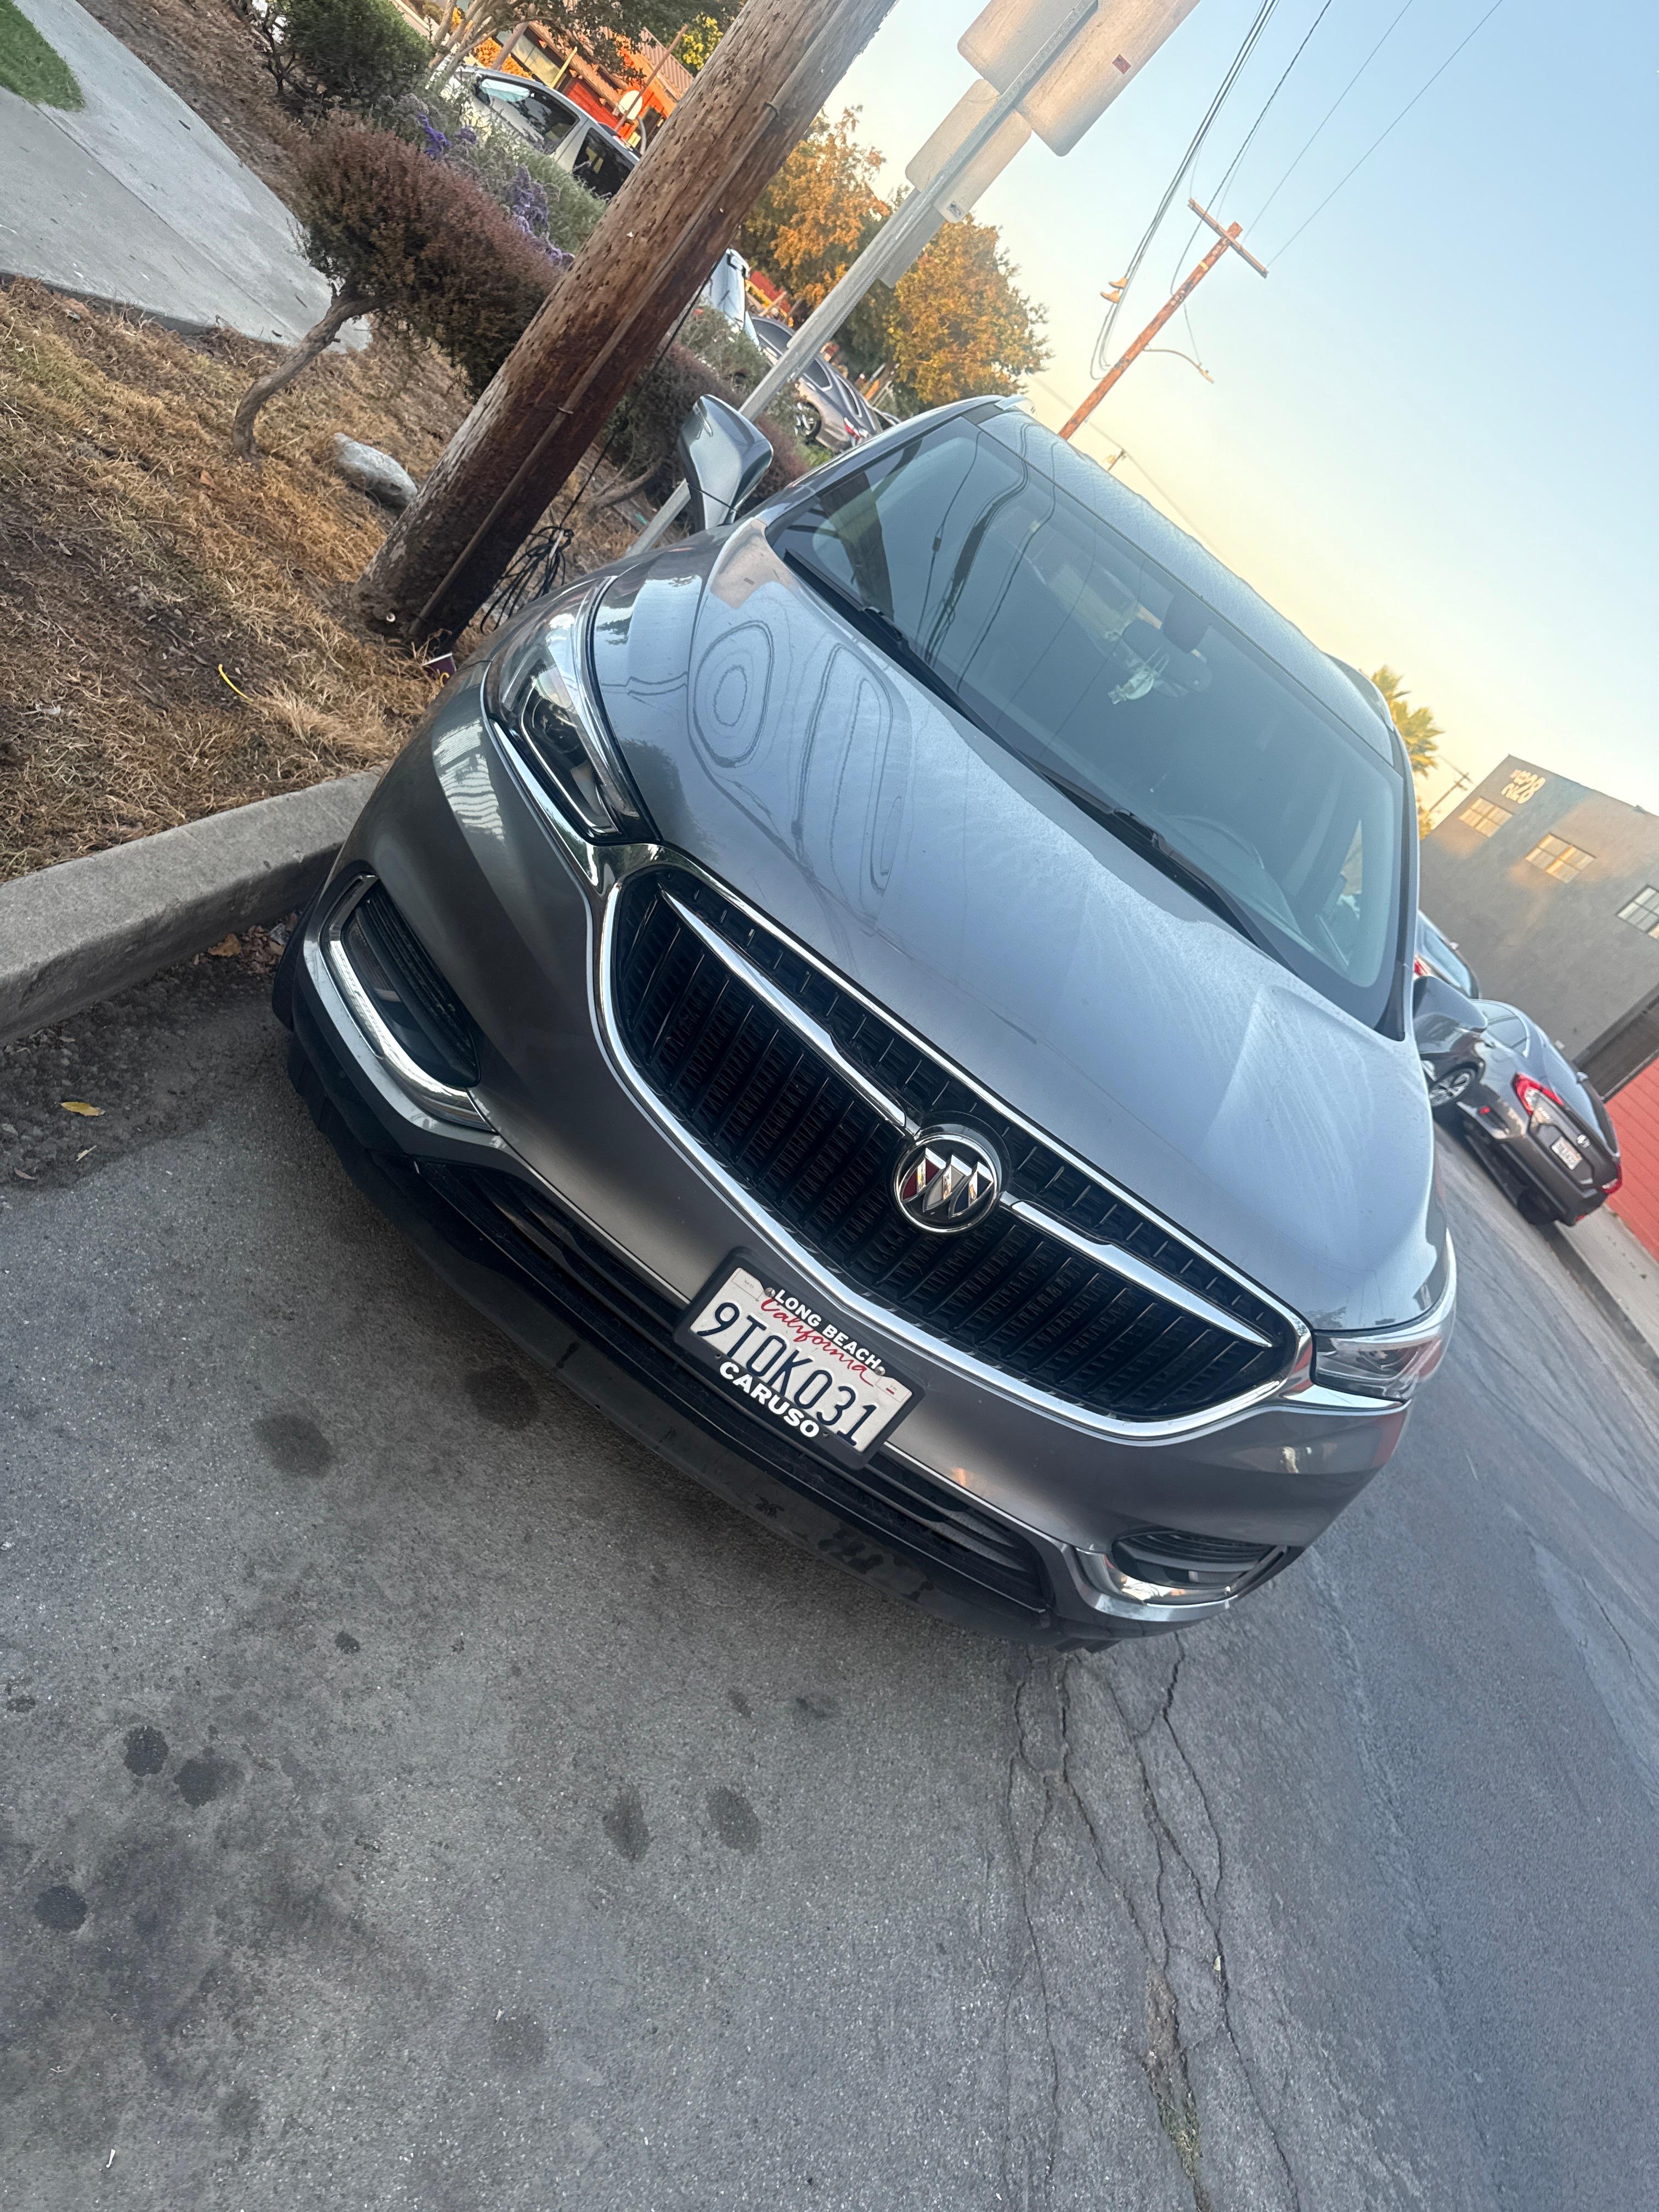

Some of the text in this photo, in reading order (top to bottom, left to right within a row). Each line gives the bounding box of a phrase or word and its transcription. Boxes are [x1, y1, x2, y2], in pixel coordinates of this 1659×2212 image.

[761, 1297, 874, 1387] California
[775, 1289, 881, 1369] LONG BEACH
[720, 1362, 820, 1437] CARUSO
